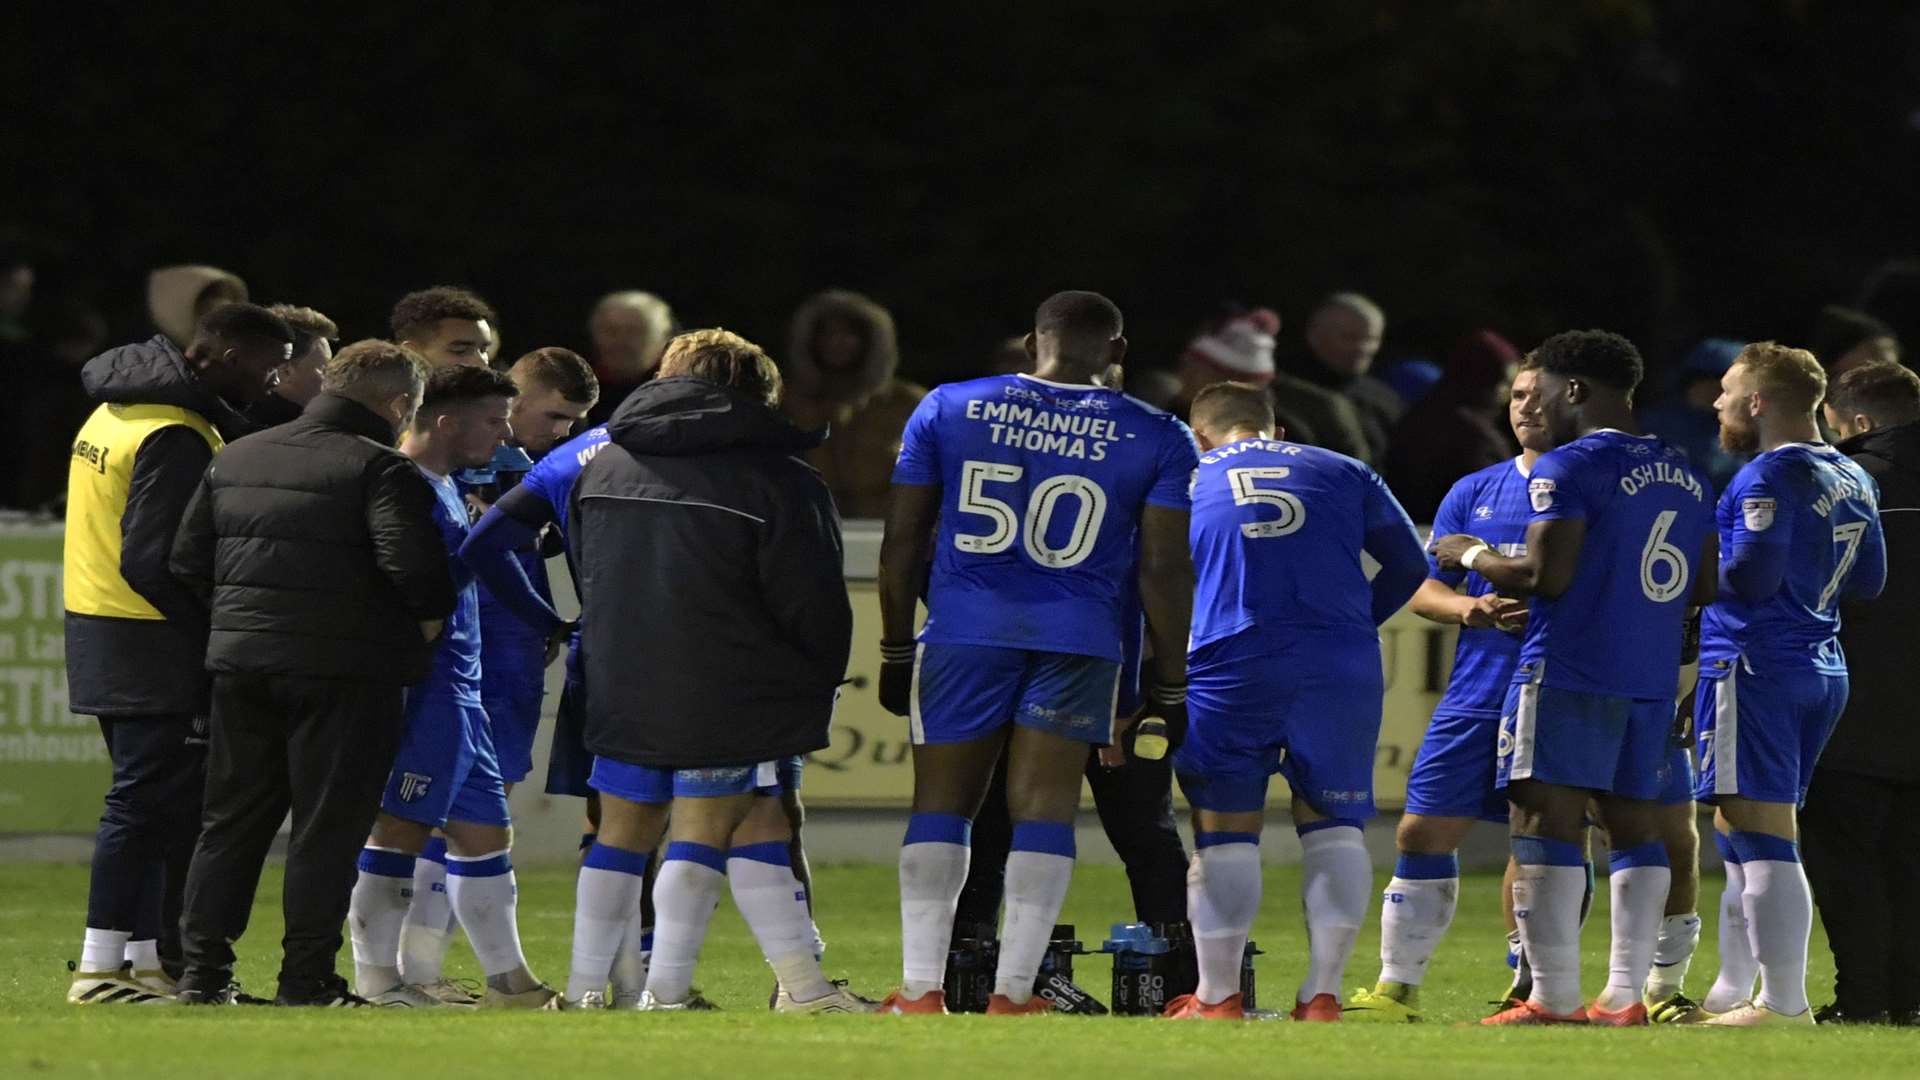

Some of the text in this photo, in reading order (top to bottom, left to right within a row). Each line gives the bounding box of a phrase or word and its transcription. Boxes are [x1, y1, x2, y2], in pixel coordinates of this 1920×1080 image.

[966, 399, 1137, 442] EMMANUEL-
[989, 423, 1108, 461] THOMAS
[1200, 441, 1303, 464] EHMER
[1227, 466, 1306, 538] 5
[1620, 462, 1703, 502] OSHILAJA
[954, 460, 1108, 569] 50
[1640, 510, 1689, 603] 6
[1817, 520, 1868, 613] 7
[1699, 729, 1716, 772] 7
